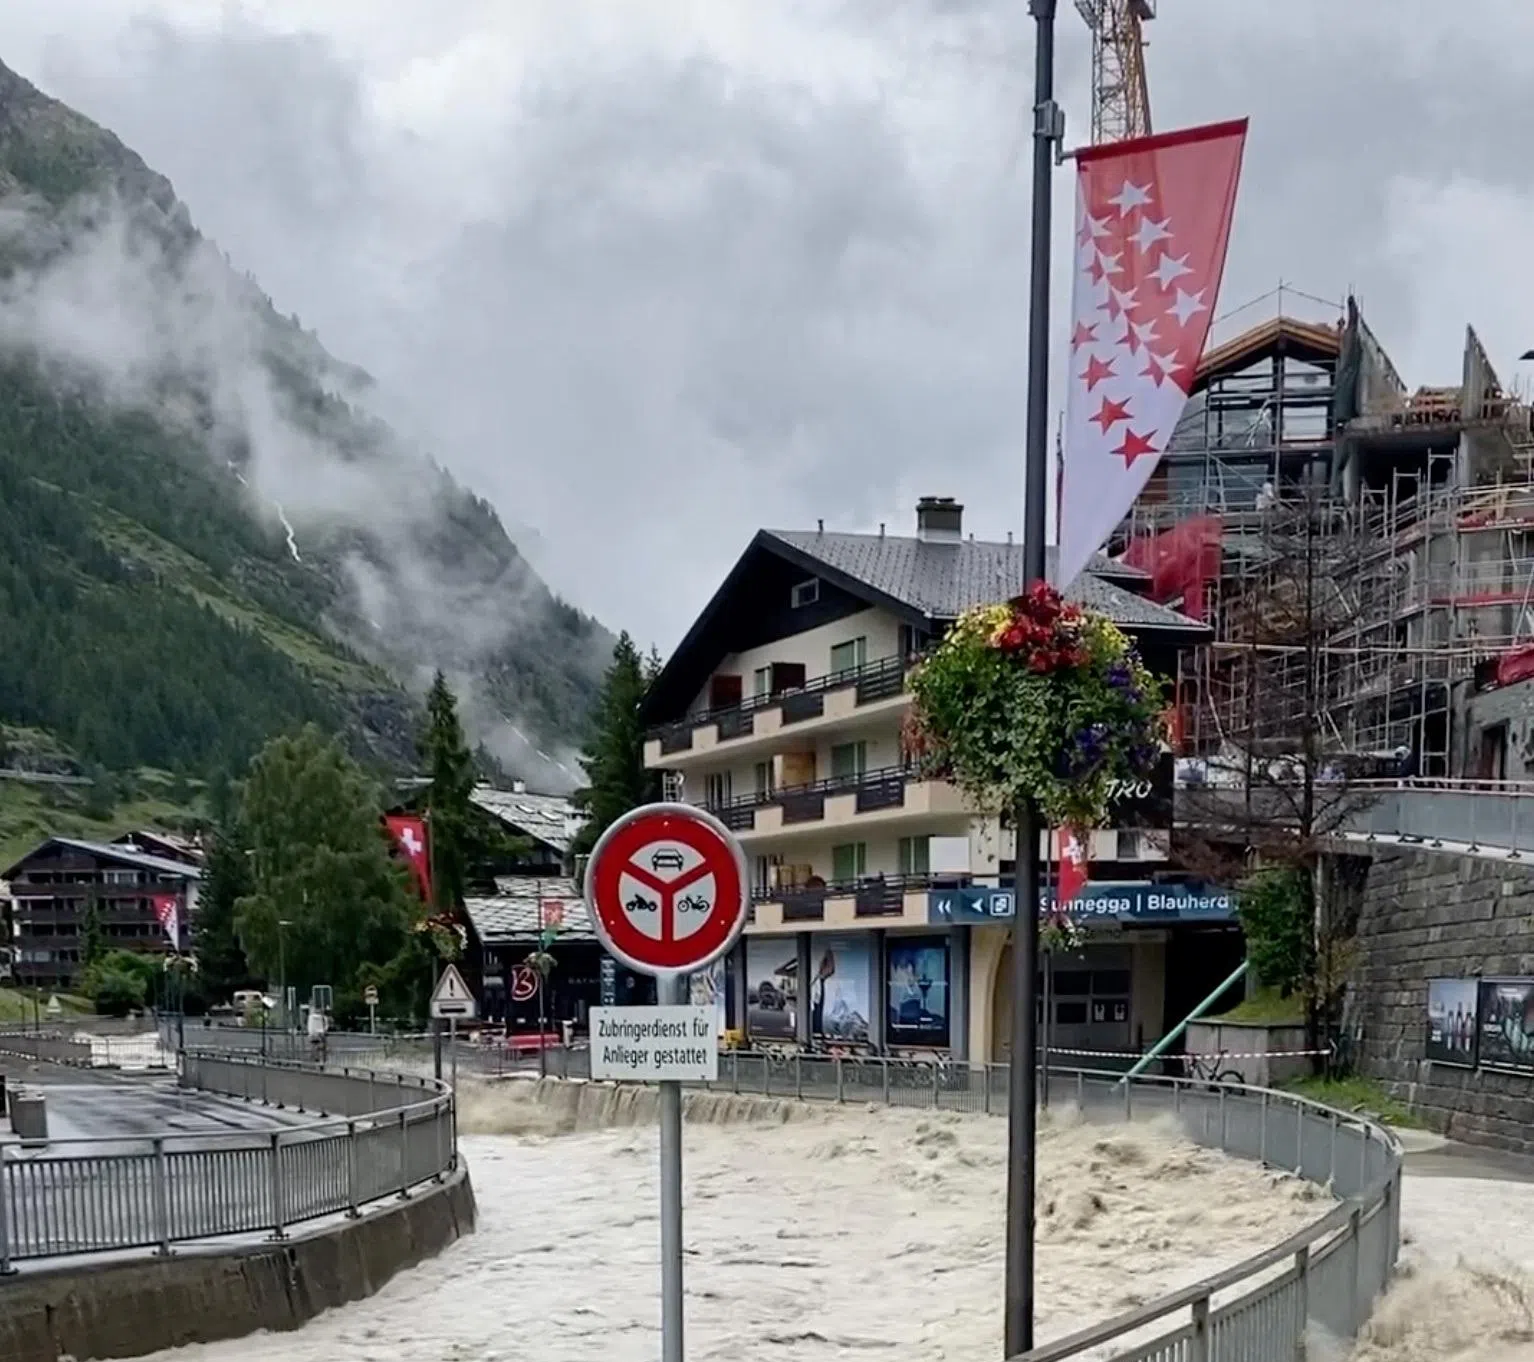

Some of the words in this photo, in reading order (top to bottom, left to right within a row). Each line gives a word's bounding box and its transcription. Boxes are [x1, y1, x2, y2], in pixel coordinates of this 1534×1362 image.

[1147, 894, 1229, 910] Blauherd
[598, 1019, 687, 1042] Zubringerdienst
[693, 1017, 709, 1037] für
[603, 1046, 650, 1068] Anlieger
[654, 1048, 707, 1068] gestattet
